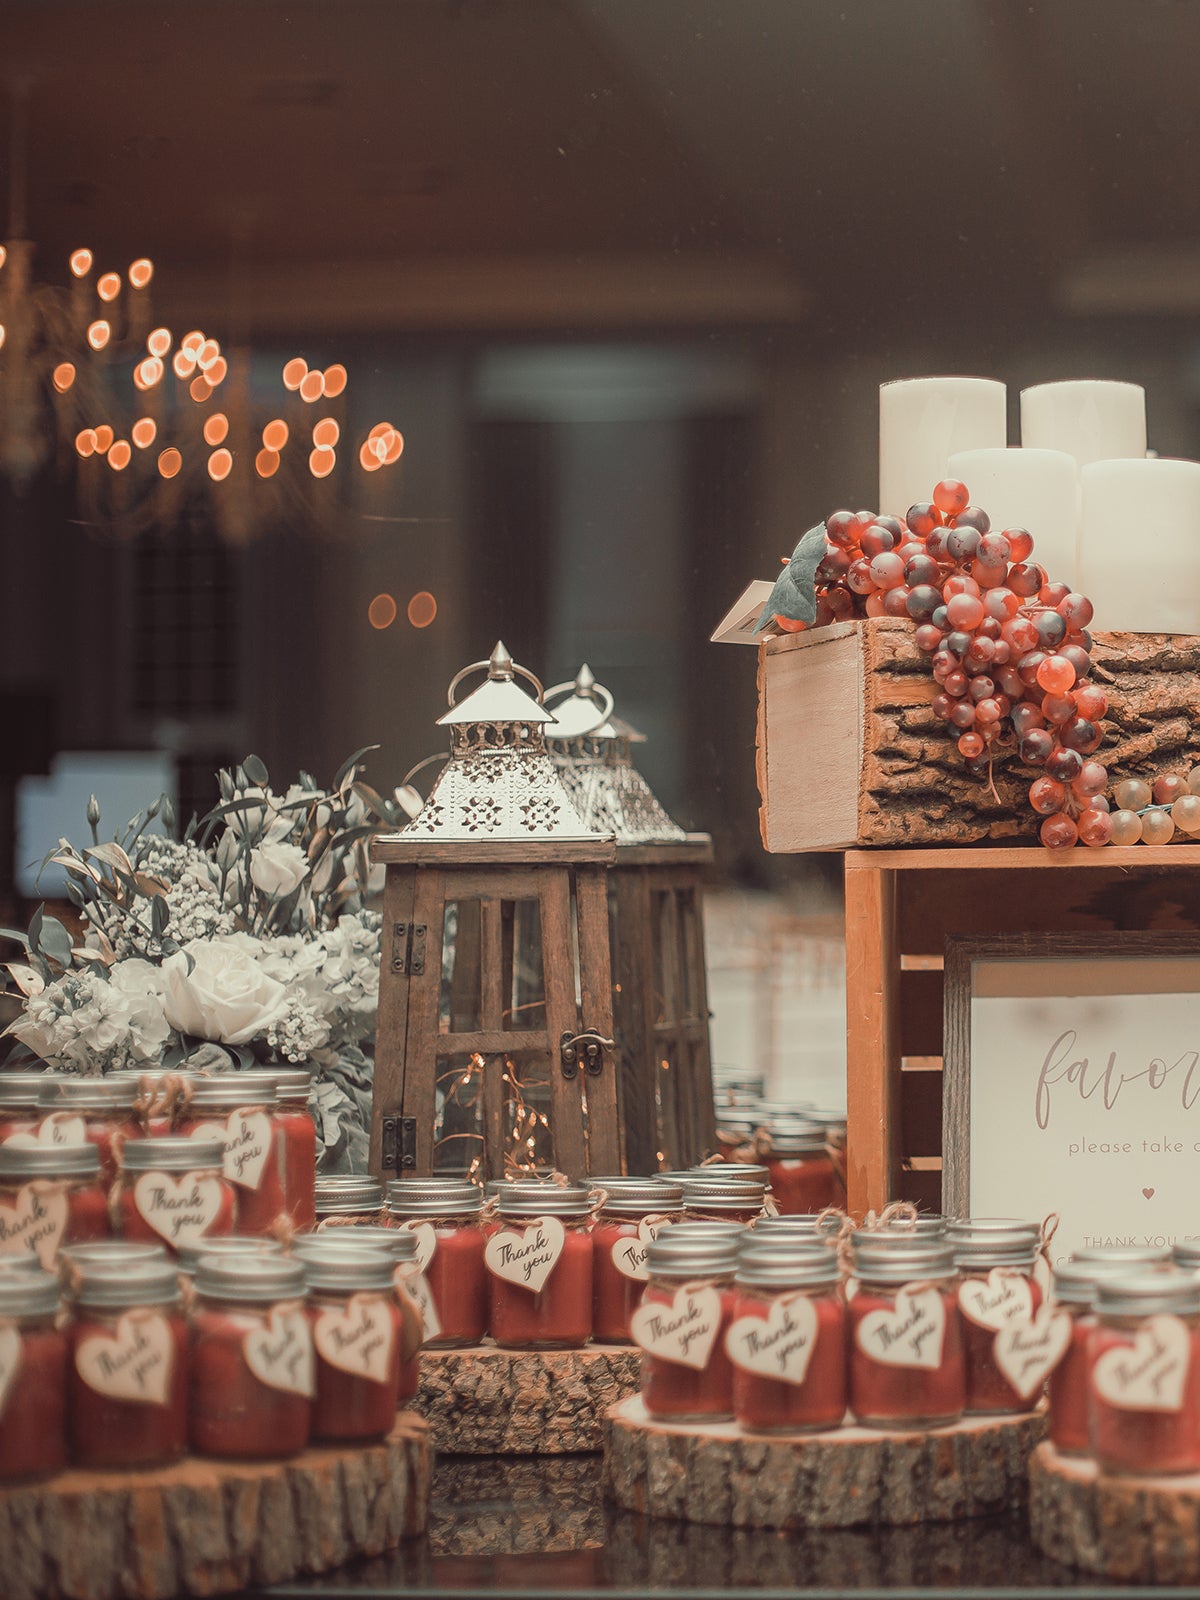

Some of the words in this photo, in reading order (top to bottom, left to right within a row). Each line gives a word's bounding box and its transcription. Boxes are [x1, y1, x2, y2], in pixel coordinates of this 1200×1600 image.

[233, 1146, 262, 1177] you
[1069, 1136, 1131, 1156] please
[1142, 1137, 1184, 1153] take
[147, 1185, 203, 1211] Thank
[24, 1221, 56, 1251] you
[171, 1214, 205, 1238] you
[1083, 1236, 1137, 1248] THANK
[1144, 1235, 1177, 1248] YOU
[497, 1229, 549, 1267] Thank
[523, 1252, 552, 1281] you
[973, 1280, 1015, 1314] Thank
[643, 1298, 701, 1342] Thank
[741, 1310, 798, 1355] Thank
[873, 1299, 925, 1350] Thank
[678, 1323, 709, 1355] you
[775, 1334, 806, 1370] you
[908, 1322, 936, 1359] you
